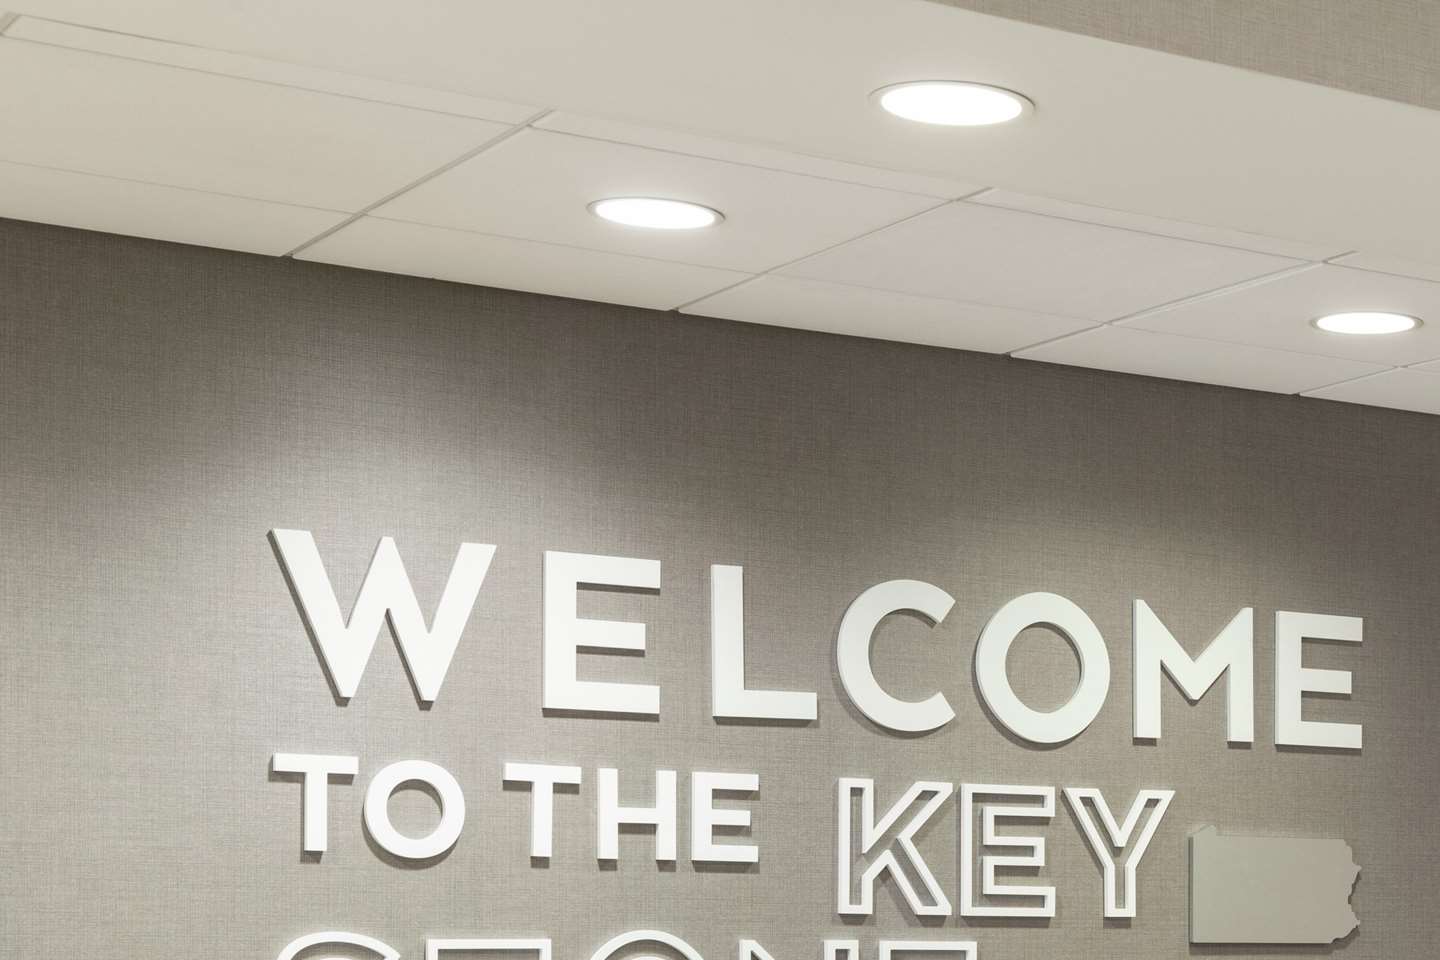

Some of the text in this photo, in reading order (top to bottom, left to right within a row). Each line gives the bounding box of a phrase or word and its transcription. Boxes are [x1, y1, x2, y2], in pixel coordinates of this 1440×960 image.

[268, 527, 1363, 750] WELCOME
[271, 752, 1176, 918] TO THE KEY
